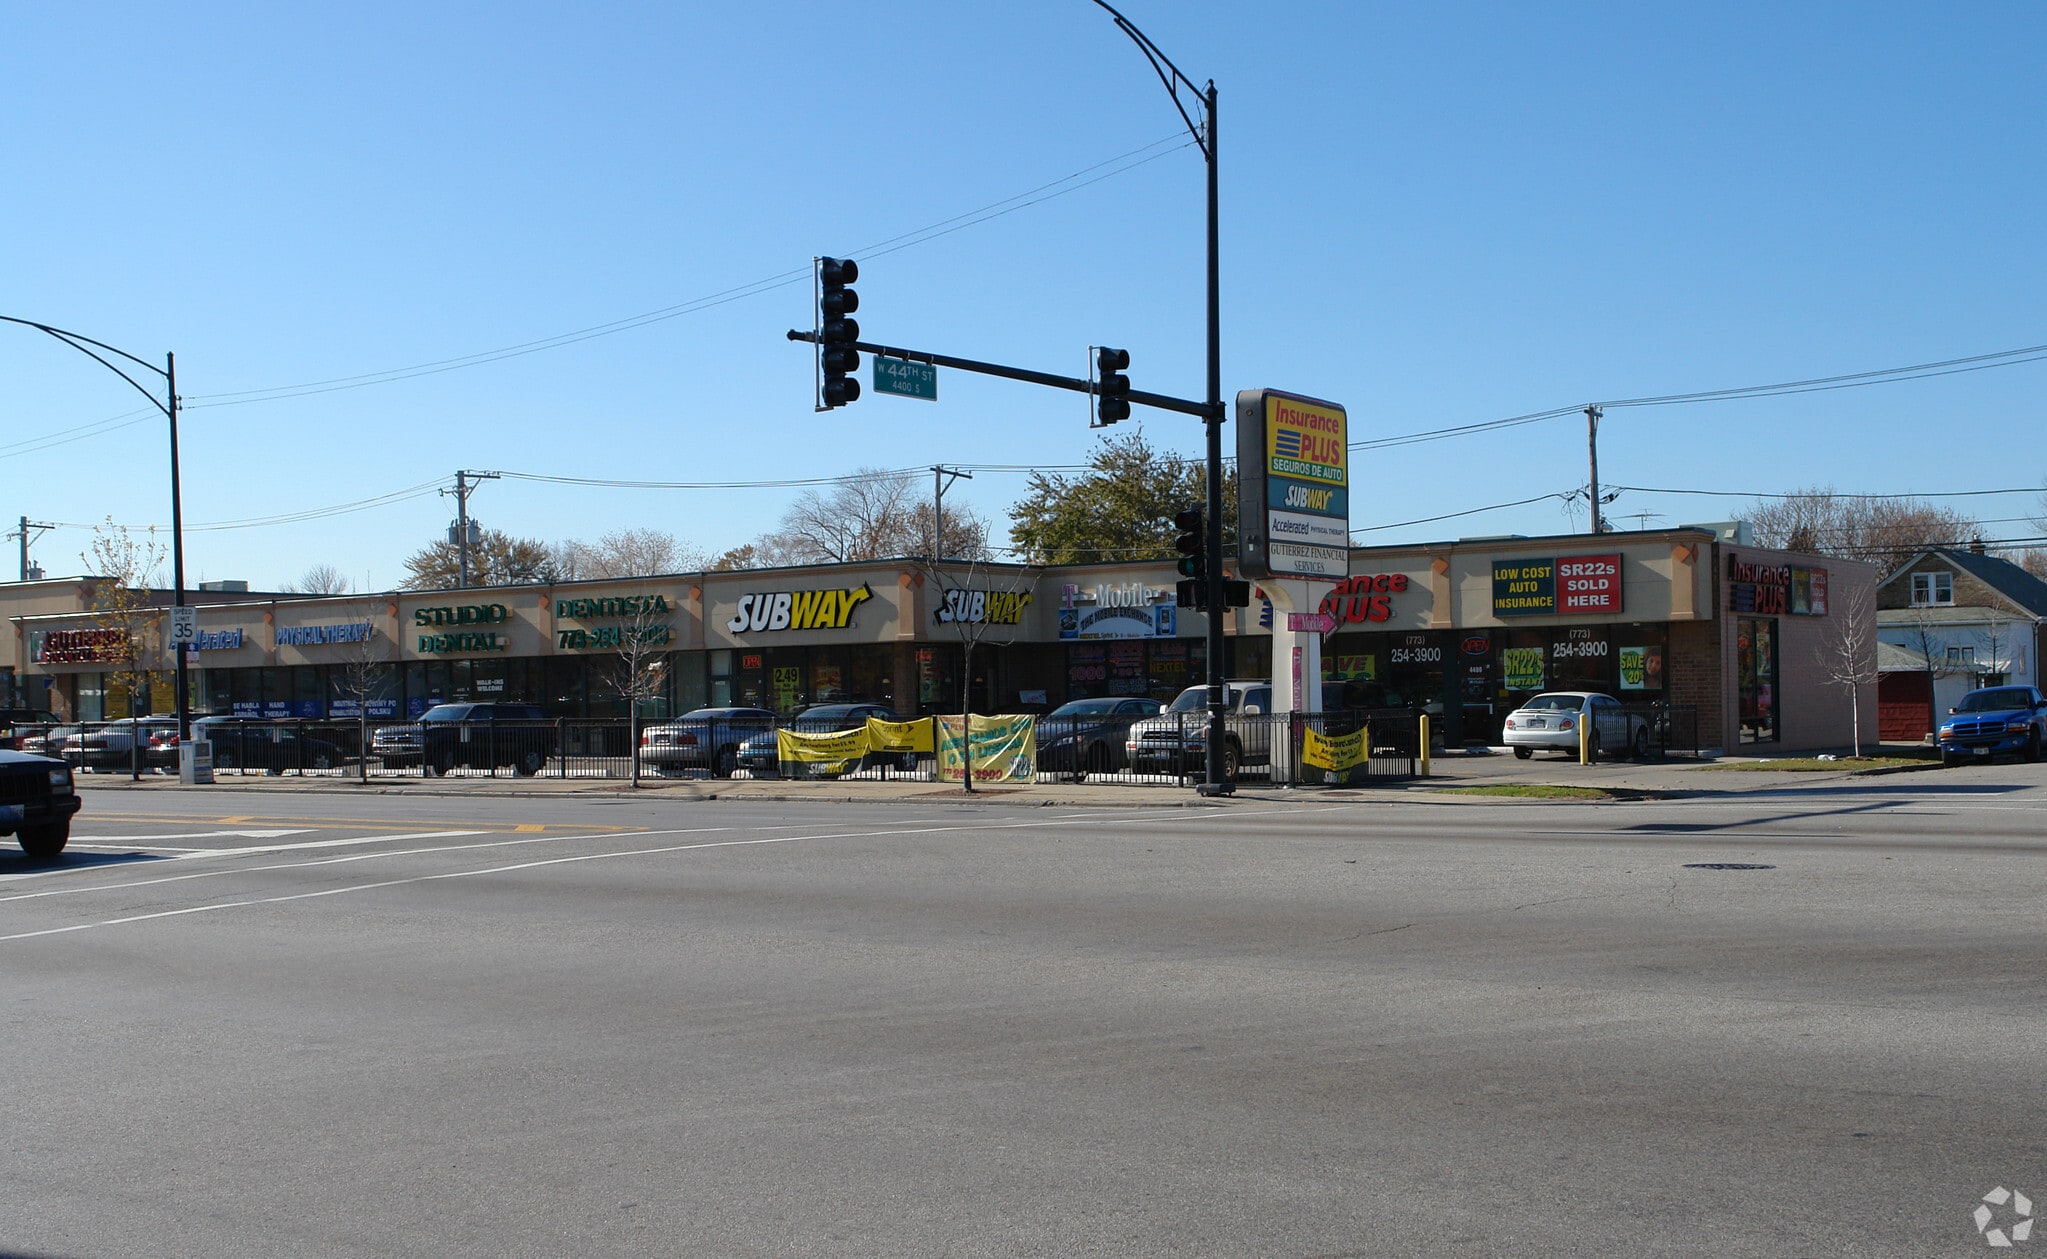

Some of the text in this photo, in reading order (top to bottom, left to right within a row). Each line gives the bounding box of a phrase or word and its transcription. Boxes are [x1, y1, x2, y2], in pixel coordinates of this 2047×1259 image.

[877, 363, 933, 382] W 44TH ST
[892, 380, 920, 394] 4400 S
[1275, 400, 1339, 435] Insurance
[1300, 433, 1340, 466] PLUS
[1273, 458, 1343, 481] SEGUROS DE AUTO
[1284, 485, 1333, 511] SUBWAY
[1271, 518, 1345, 537] Accelerated PHYSICAL THERAPY
[1271, 543, 1346, 562] GUTIERREZ FINANCIAL
[1294, 560, 1326, 573] SERVICES
[1494, 566, 1552, 580] LOW COST
[1560, 562, 1616, 577] SR22s
[1730, 556, 1790, 586] Insurance
[1509, 581, 1538, 593] AUTO
[1567, 579, 1609, 591] SOLD
[1495, 596, 1553, 609] INSURANCE
[1567, 595, 1610, 607] HERE
[1755, 584, 1786, 614] PLUS
[556, 595, 669, 619] DENTISTA
[726, 582, 873, 636] SUBWAY
[936, 589, 1034, 625] SUBWAY
[414, 603, 507, 627] STUDIO
[174, 623, 193, 638] 35
[276, 623, 373, 646] PHYSICAL THERAPY
[1568, 629, 1591, 639] (773)
[418, 632, 504, 654] DENTAL
[1405, 635, 1426, 646] (773)
[1461, 640, 1490, 652] OPEN
[1391, 647, 1441, 662] 254-3900
[1553, 641, 1608, 658] 254-3900
[1150, 661, 1187, 674] NEXTEL
[1320, 656, 1368, 673] AVE
[1620, 655, 1644, 669] SAVE
[775, 668, 797, 683] 2.49
[1506, 677, 1542, 687] INSTANT
[808, 762, 849, 775] SUBWAY
[952, 768, 1003, 780] 25-3900
